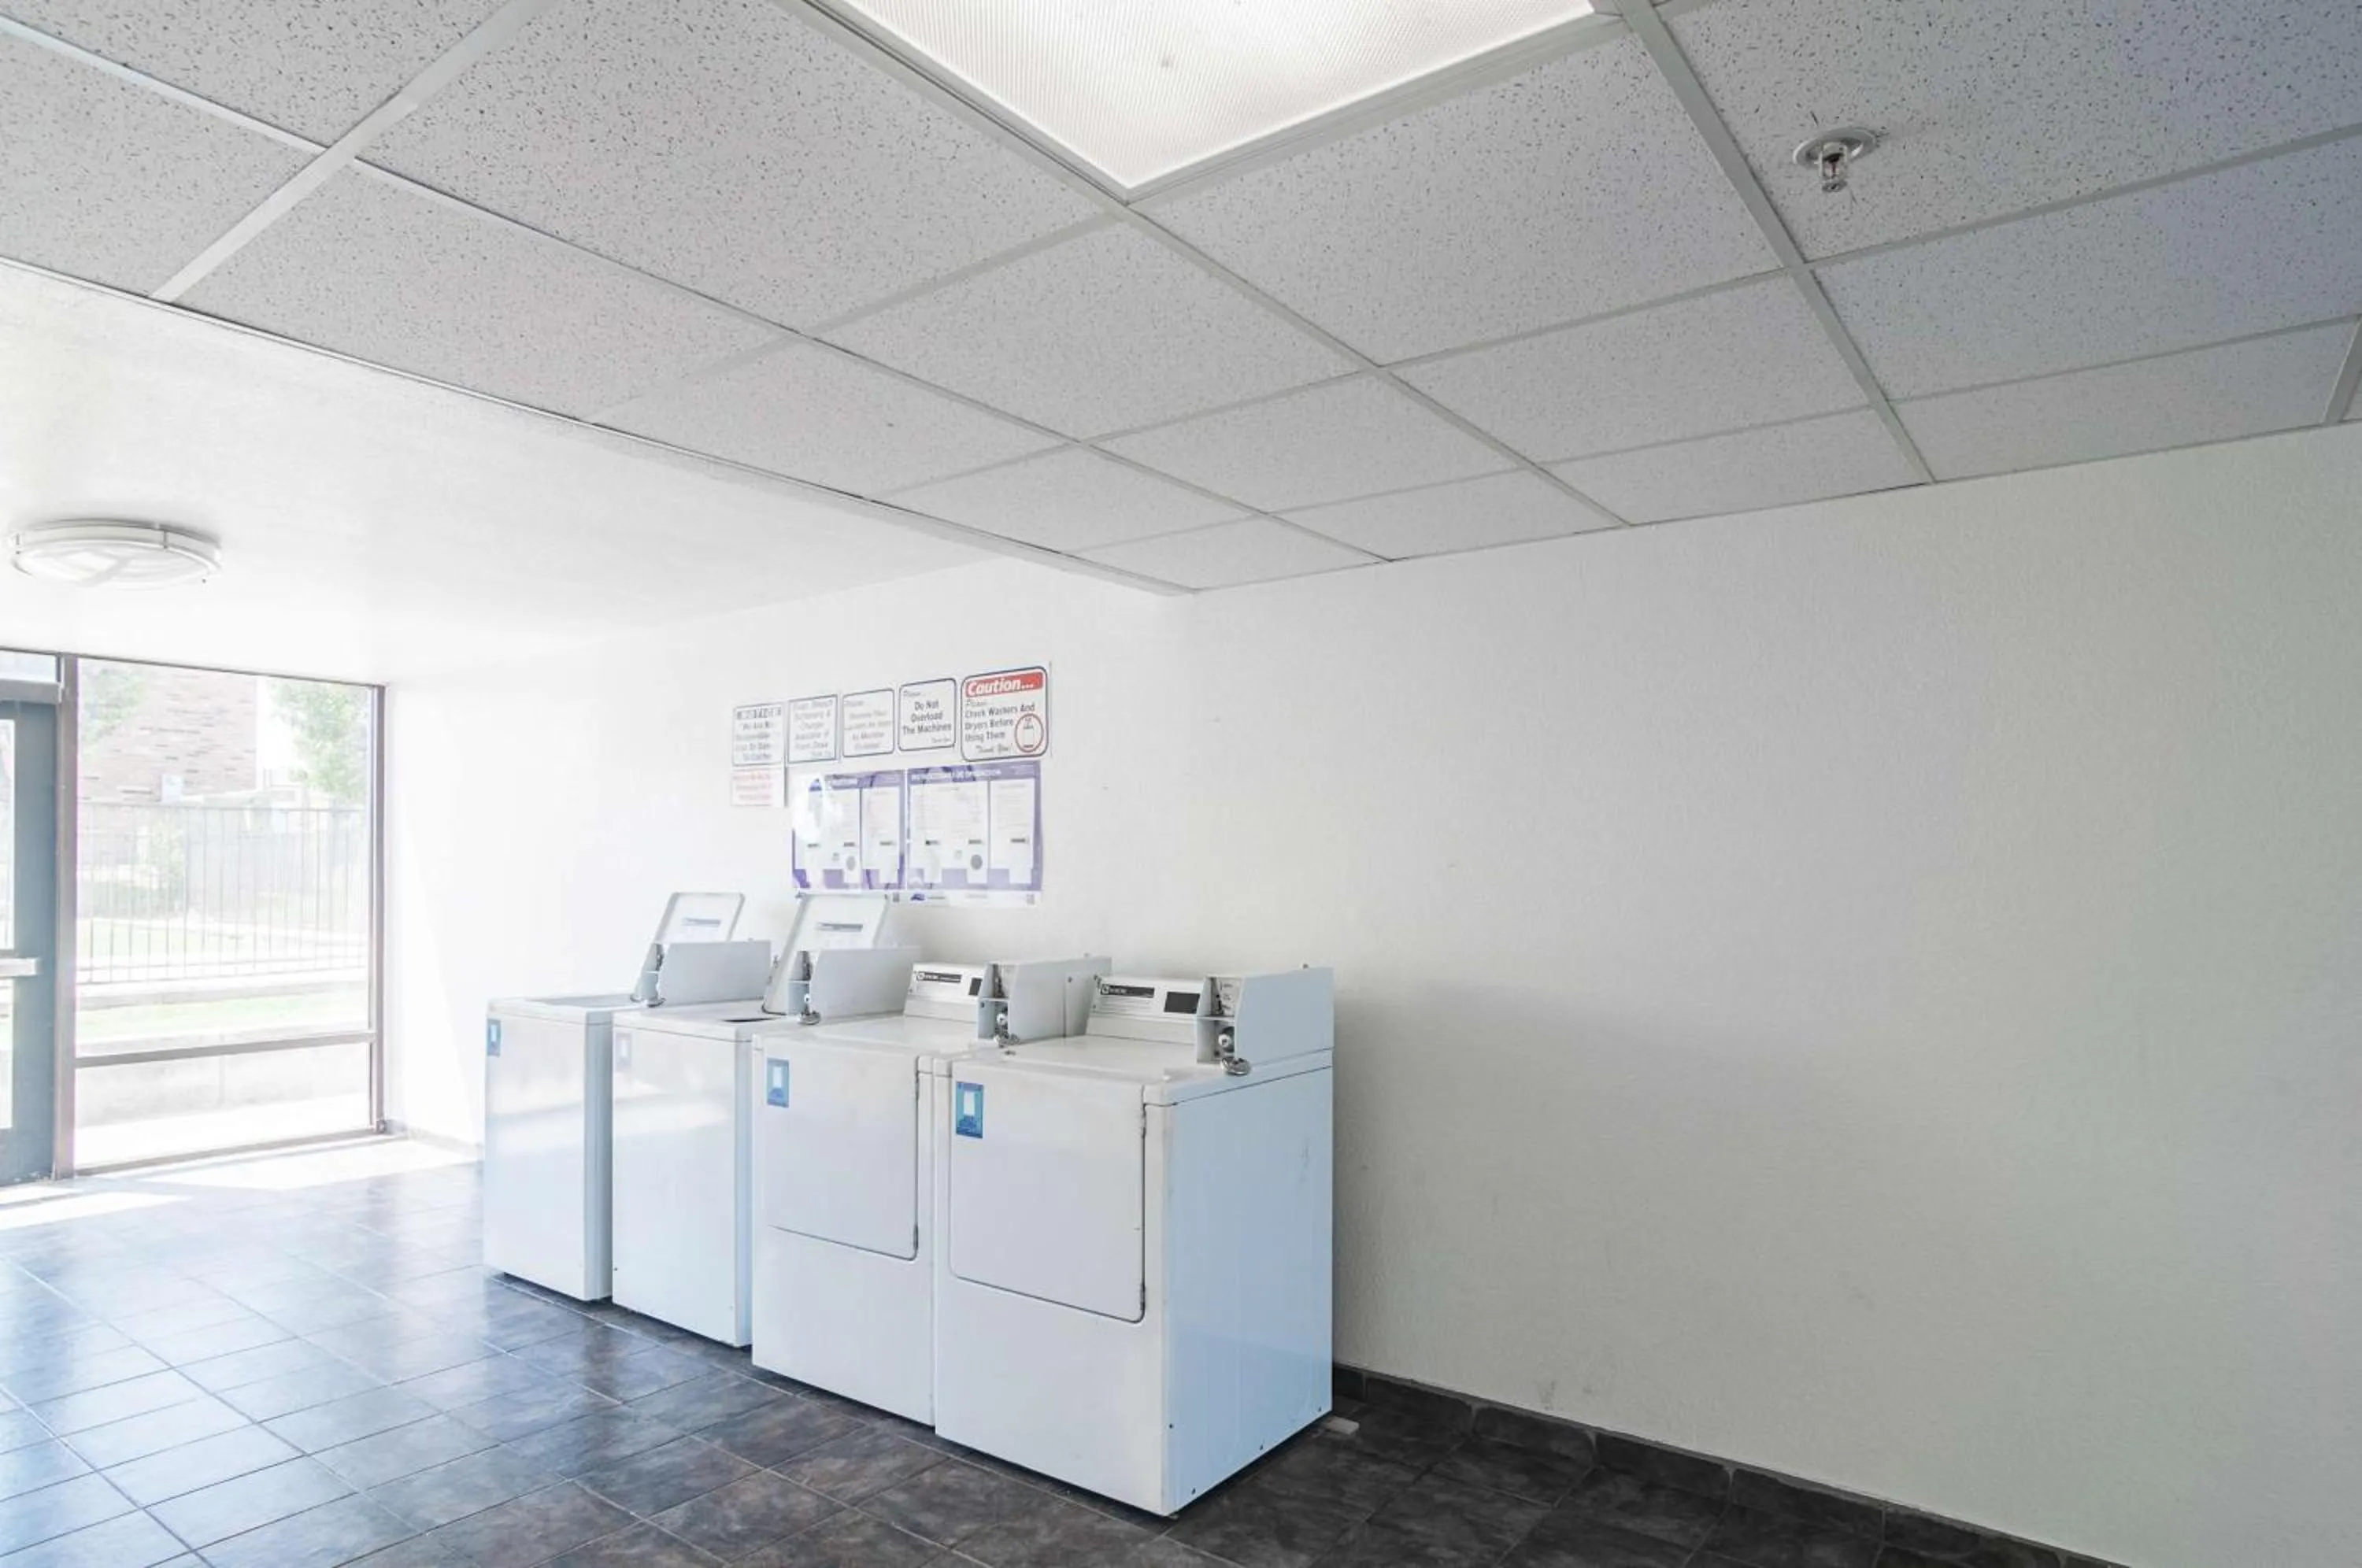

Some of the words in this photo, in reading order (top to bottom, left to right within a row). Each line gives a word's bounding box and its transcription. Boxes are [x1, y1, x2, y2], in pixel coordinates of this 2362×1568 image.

[914, 701, 924, 711] Do
[926, 700, 939, 709] Not
[964, 709, 986, 719] Check
[988, 706, 1018, 716] Washers
[1020, 702, 1035, 712] And
[910, 711, 943, 723] Overload
[902, 725, 915, 735] The
[917, 722, 952, 733] Machines
[964, 721, 987, 731] Dryers
[990, 719, 1014, 728] Before
[964, 733, 984, 743] Using
[987, 730, 1006, 740] Them
